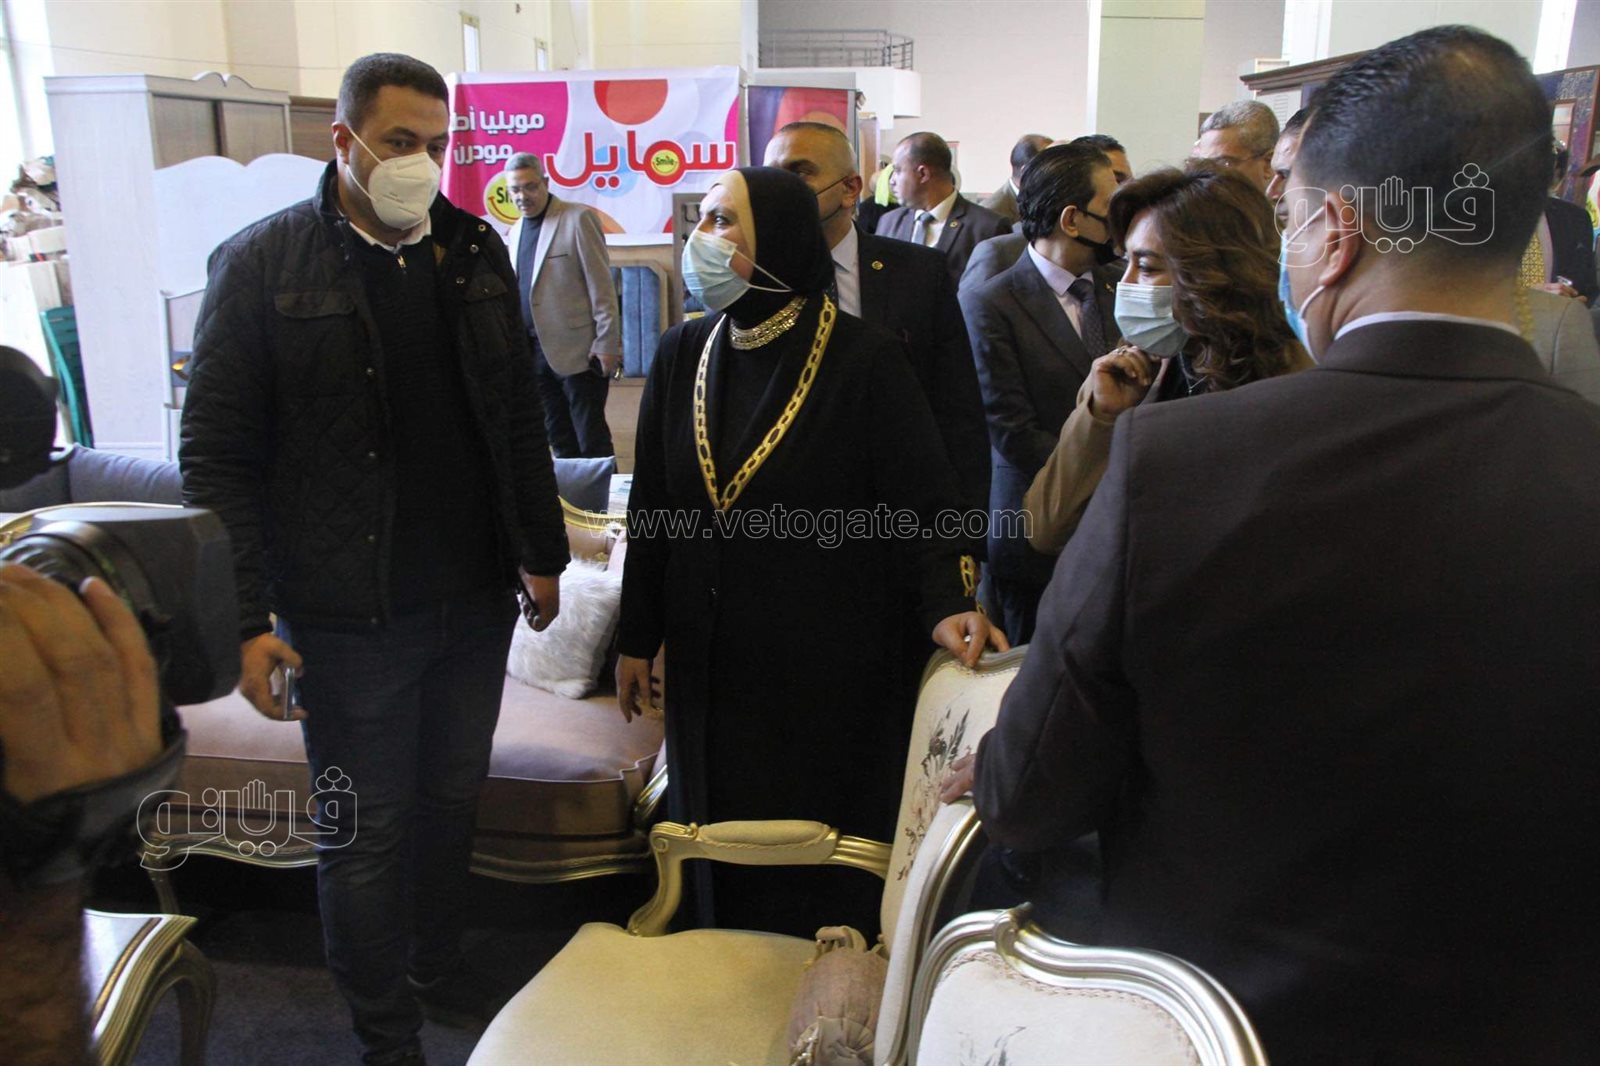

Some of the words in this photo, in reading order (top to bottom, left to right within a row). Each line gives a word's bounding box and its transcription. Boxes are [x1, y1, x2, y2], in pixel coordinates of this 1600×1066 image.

[449, 105, 477, 132] أط
[479, 110, 545, 134] موبليا
[453, 142, 514, 165] مودرن
[545, 130, 736, 187] سمايل
